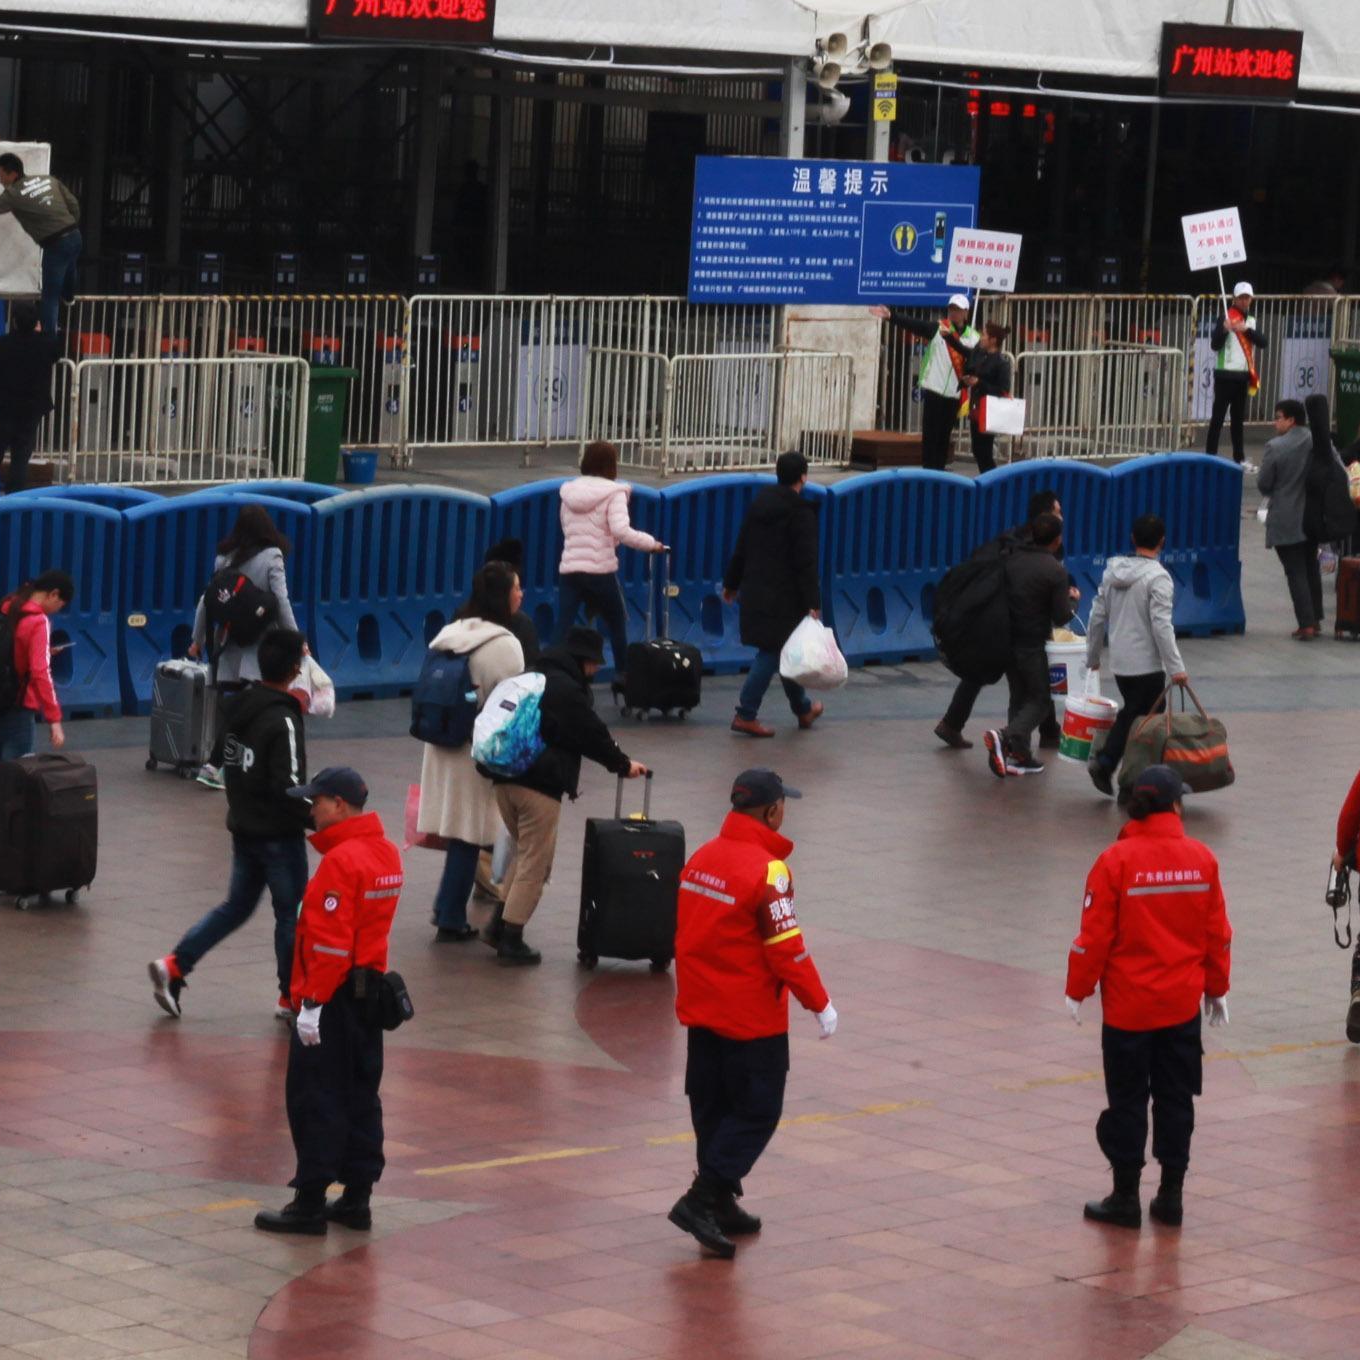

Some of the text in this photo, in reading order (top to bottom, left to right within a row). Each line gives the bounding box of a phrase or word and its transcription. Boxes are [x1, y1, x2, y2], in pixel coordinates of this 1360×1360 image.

[1171, 44, 1295, 80] 广州站欢迎您
[792, 167, 889, 196] 温馨提示
